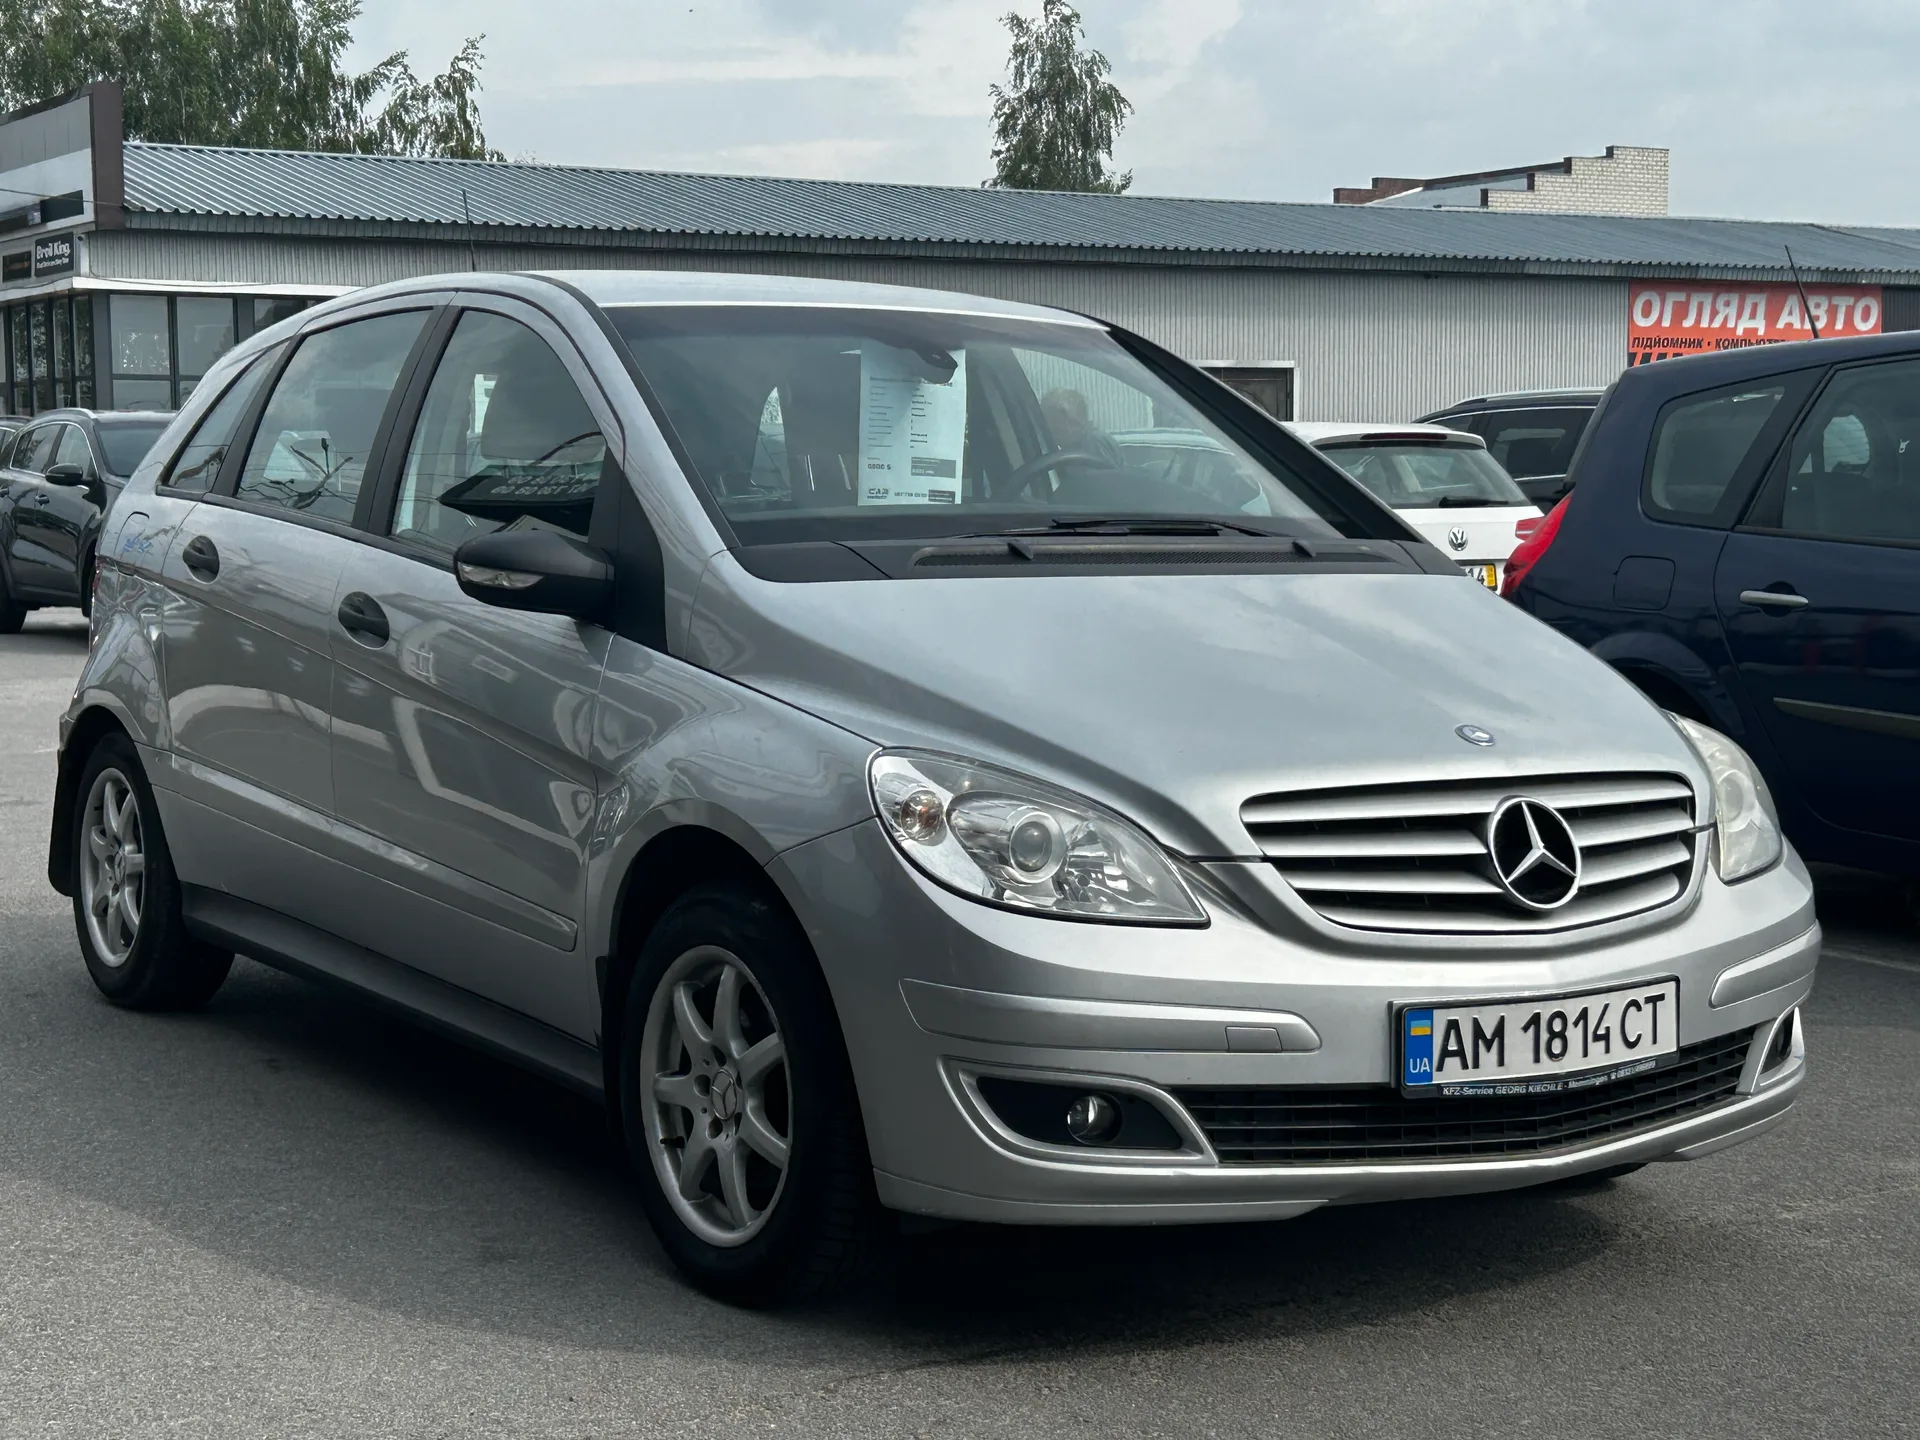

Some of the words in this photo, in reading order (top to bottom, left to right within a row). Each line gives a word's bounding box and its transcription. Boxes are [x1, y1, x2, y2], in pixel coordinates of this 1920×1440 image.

[1633, 291, 1767, 335] ОГЛЯД
[1776, 295, 1879, 332] АВТО
[1631, 335, 1704, 350] ПІДЙОМНИК
[1435, 1014, 1505, 1072] AM
[1521, 1002, 1611, 1063] 1814
[1620, 993, 1666, 1050] CT
[1409, 1057, 1431, 1073] UA
[1443, 1086, 1494, 1096] KFZ-Service
[1495, 1085, 1527, 1095] GEORG
